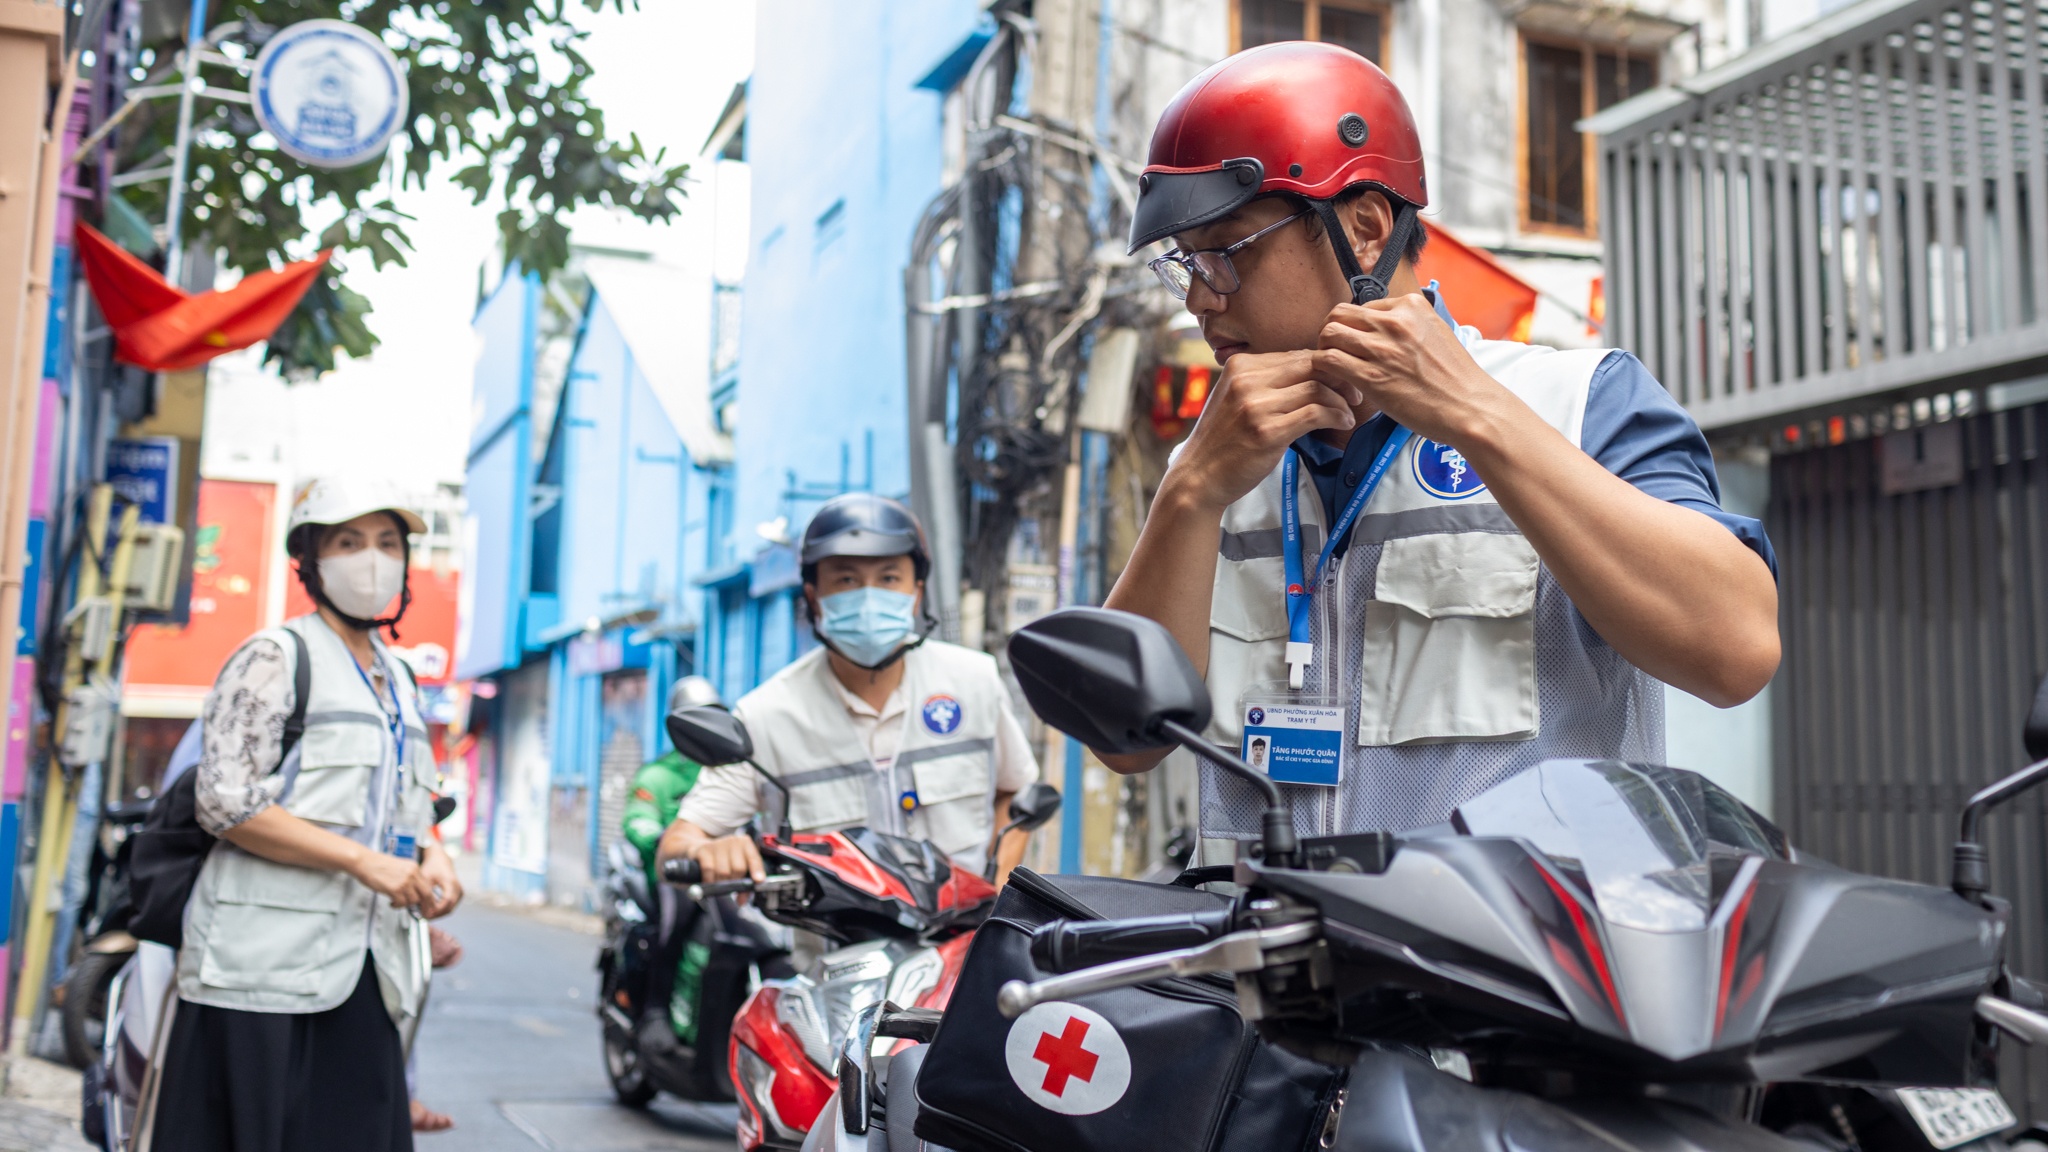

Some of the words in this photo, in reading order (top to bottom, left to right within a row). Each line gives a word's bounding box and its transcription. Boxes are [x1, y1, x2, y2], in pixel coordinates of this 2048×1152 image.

[1384, 443, 1396, 458] MINH
[1272, 746, 1290, 754] TĂNG
[1291, 747, 1315, 756] PHƯỚC
[1316, 748, 1337, 757] QUÂN
